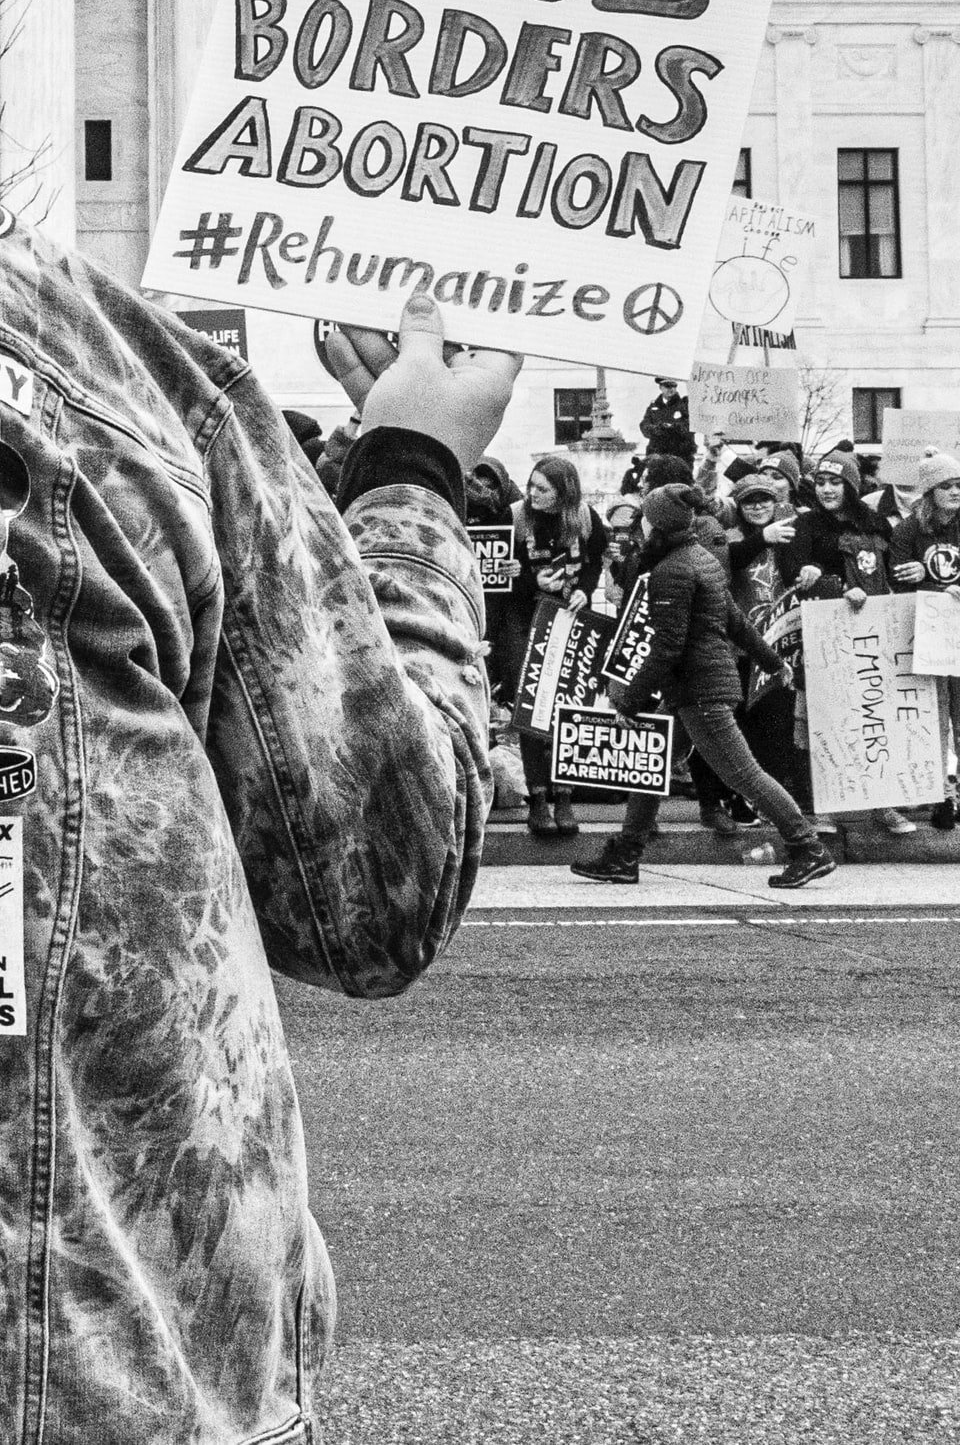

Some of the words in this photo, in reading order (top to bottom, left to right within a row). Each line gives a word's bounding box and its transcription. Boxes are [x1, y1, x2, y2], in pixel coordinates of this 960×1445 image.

[183, 96, 706, 250] ABORTION
[729, 207, 816, 238] APITALISM
[172, 210, 611, 323] #Rehumanize
[561, 619, 584, 678] REJECT
[565, 629, 601, 706] bortion
[615, 664, 626, 672] I
[622, 630, 640, 660] AM
[525, 663, 542, 697] AM
[852, 634, 890, 763] EMPOWERS
[894, 650, 919, 722] LIFE
[559, 744, 664, 772] PLANNED
[560, 722, 666, 753] DEFUND
[558, 762, 664, 786] PARENTHOOD
